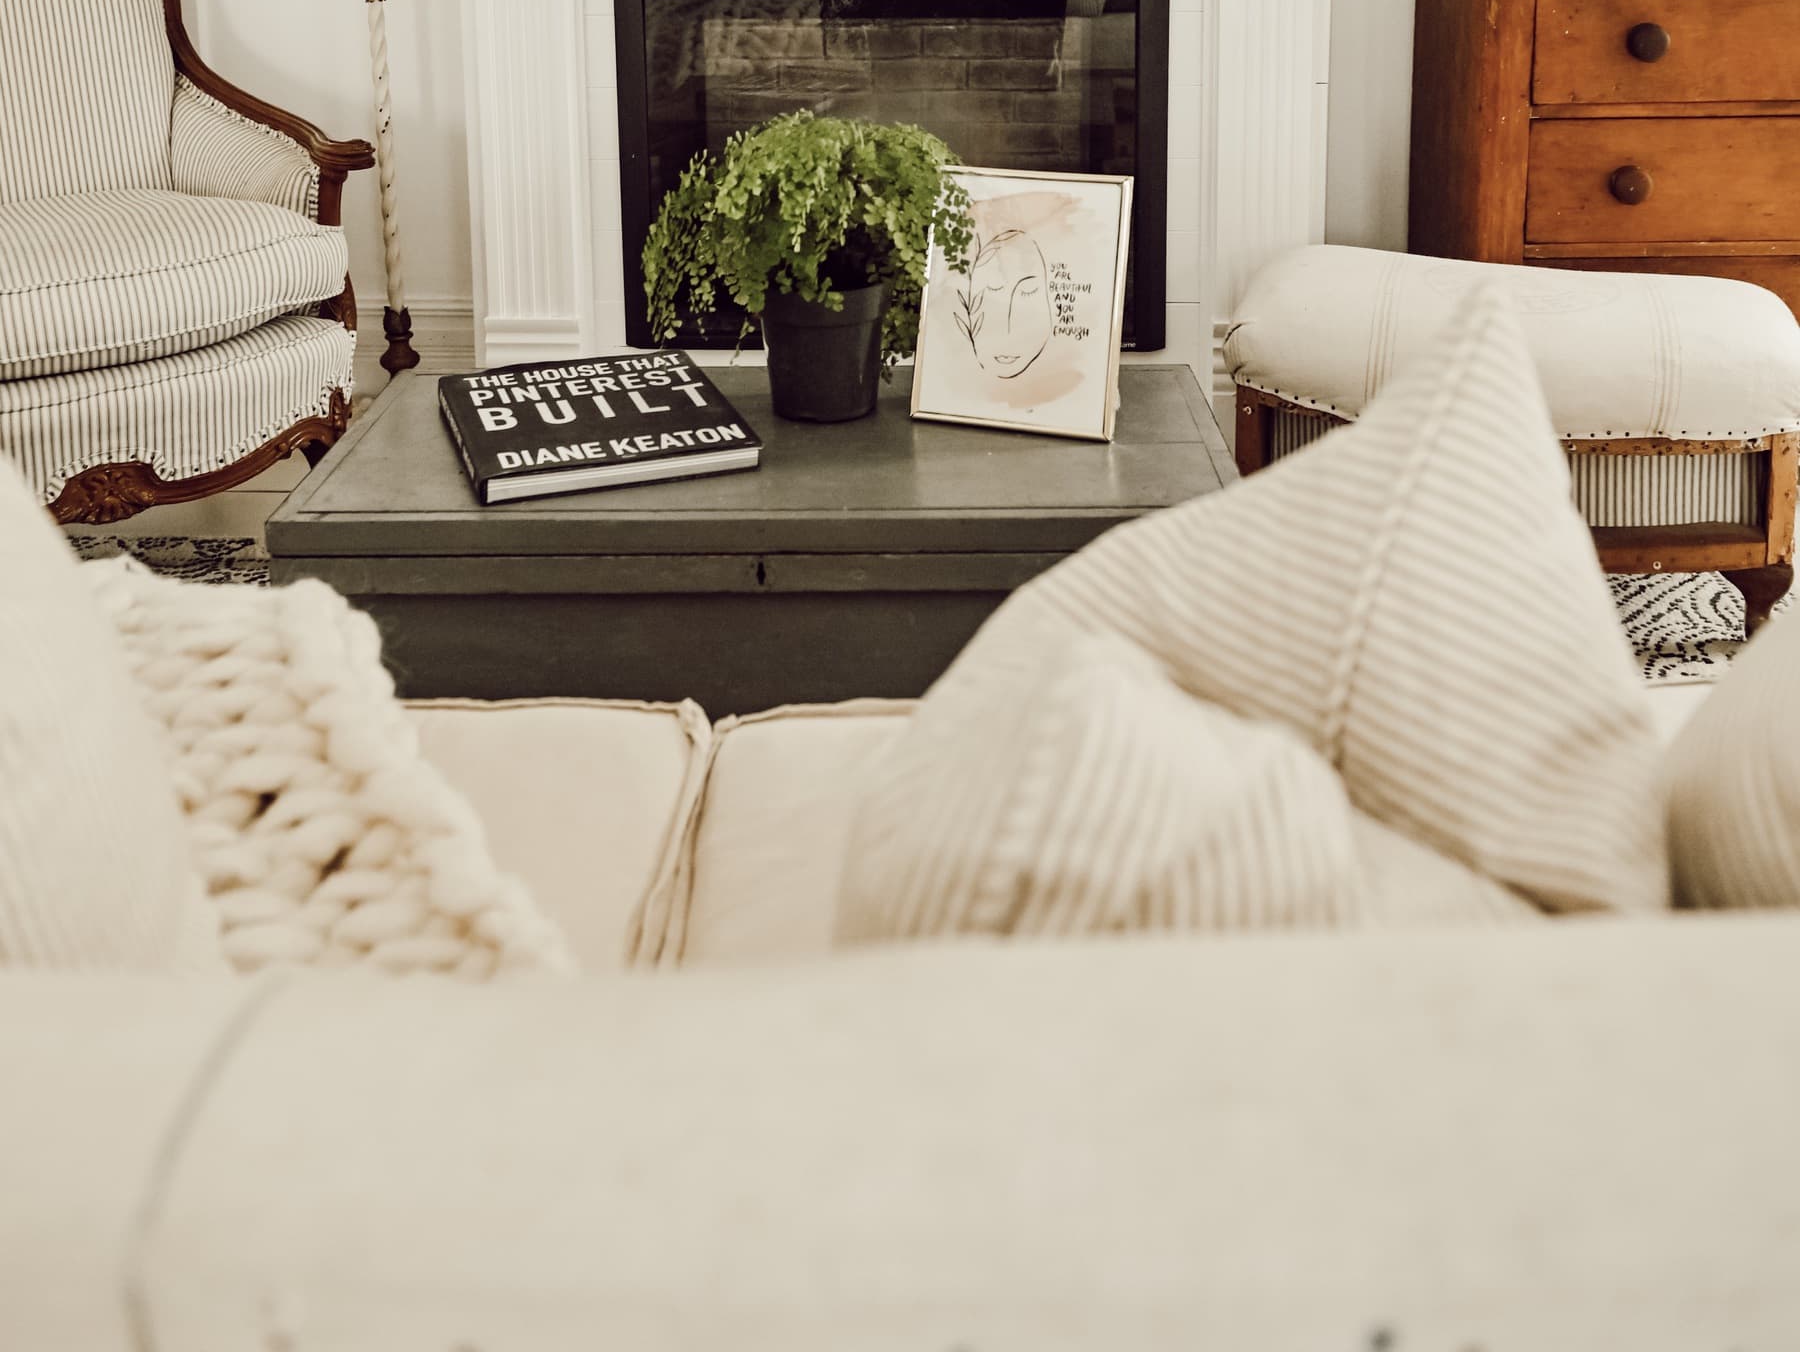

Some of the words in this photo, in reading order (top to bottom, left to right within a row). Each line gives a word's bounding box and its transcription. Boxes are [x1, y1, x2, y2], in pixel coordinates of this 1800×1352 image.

[463, 373, 516, 389] THE
[524, 363, 614, 384] HOUSE
[615, 353, 681, 370] THAT
[469, 366, 693, 406] PINTEREST
[477, 383, 709, 432] BUILT
[497, 441, 606, 469] DIANE
[609, 423, 746, 456] KEATON
